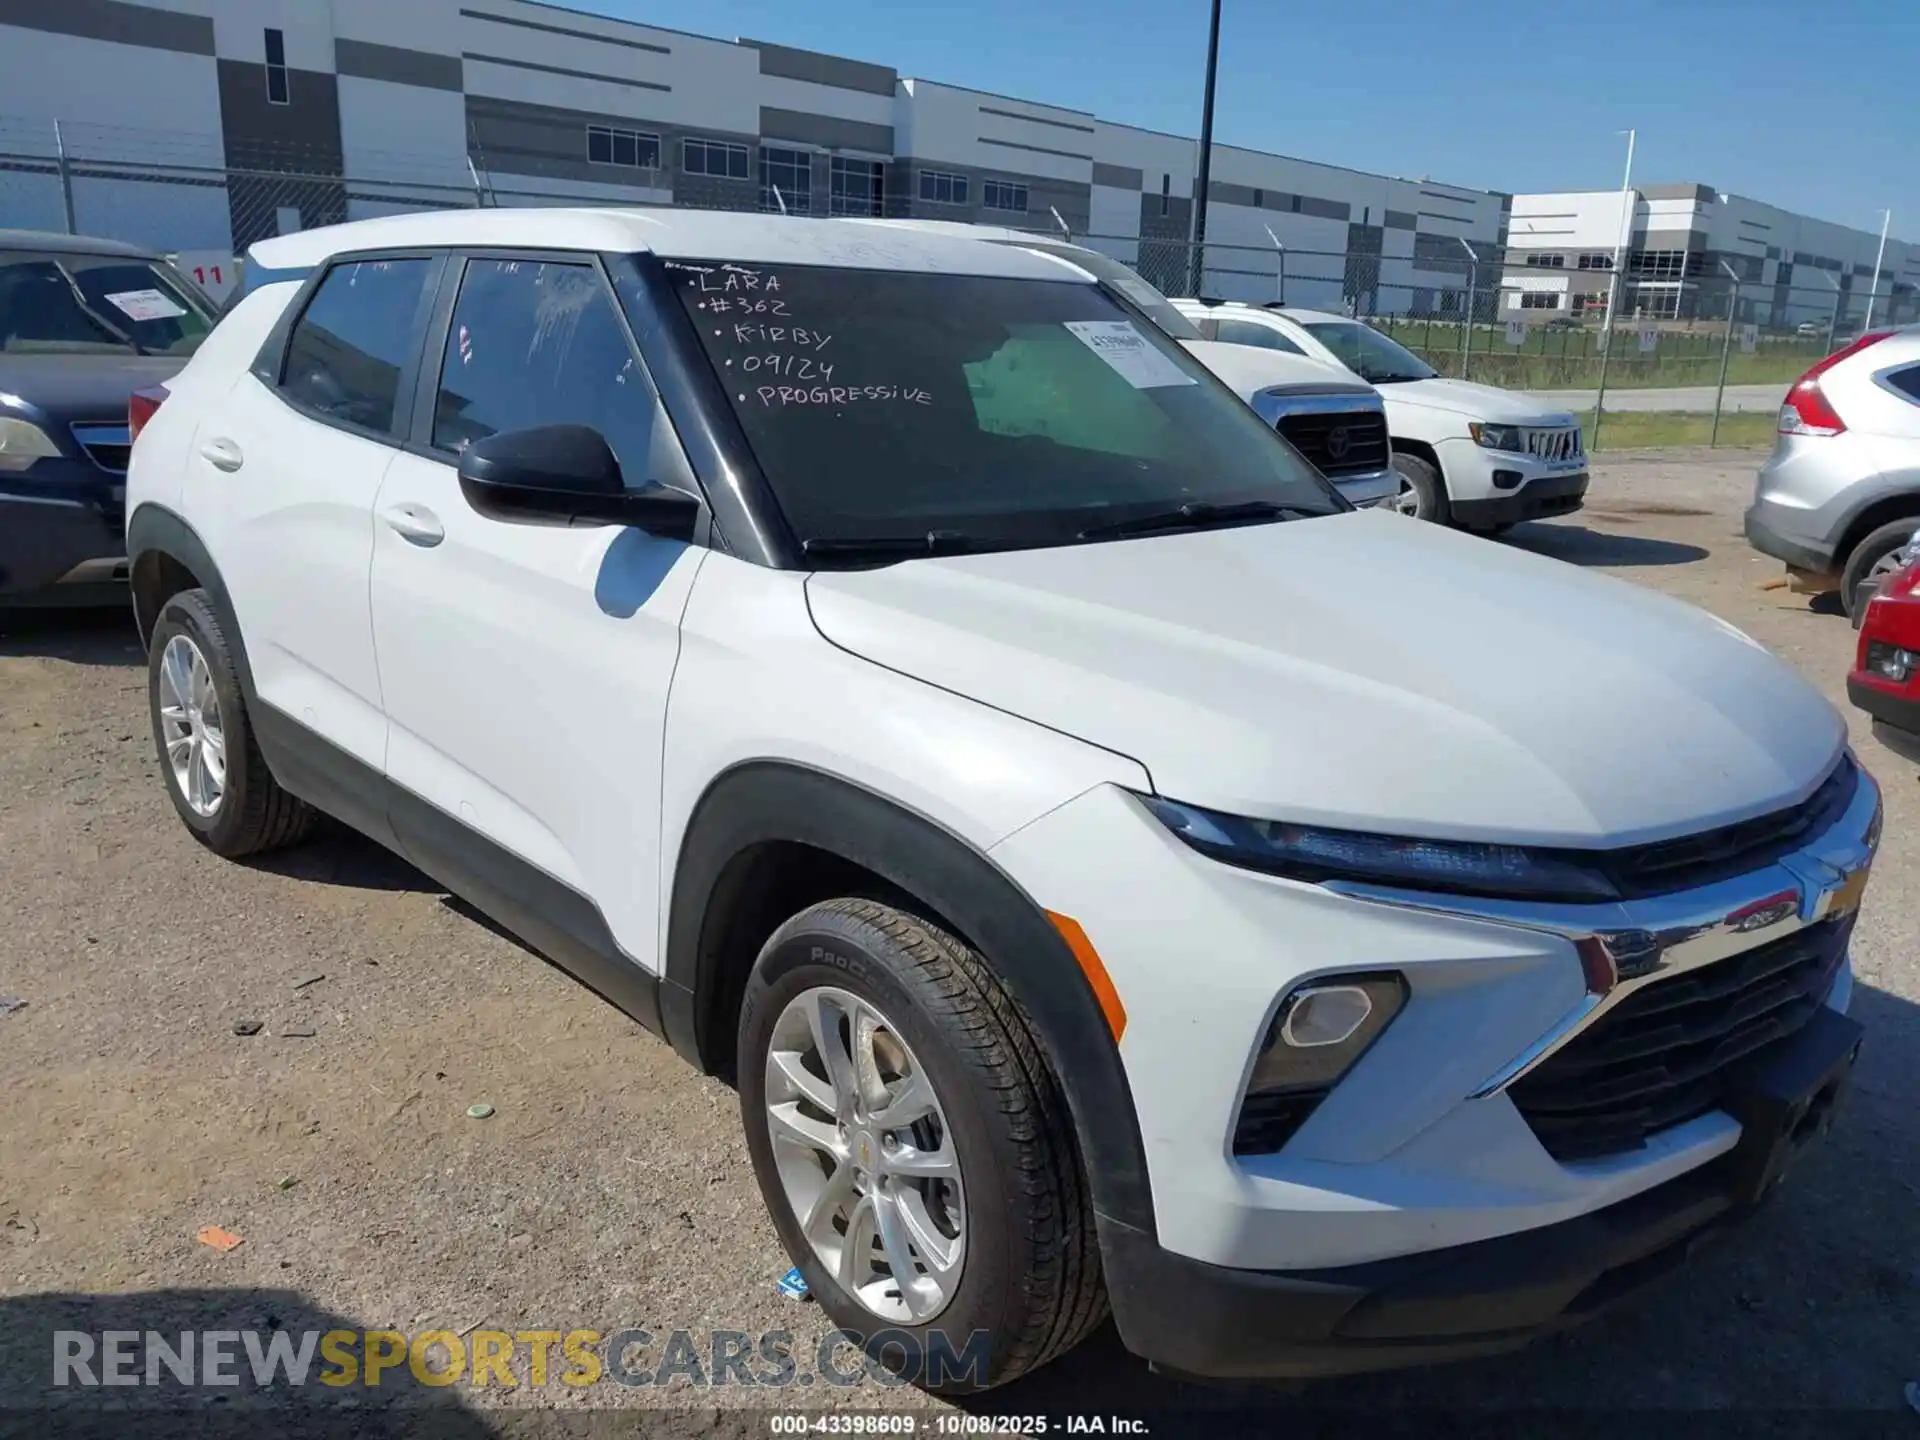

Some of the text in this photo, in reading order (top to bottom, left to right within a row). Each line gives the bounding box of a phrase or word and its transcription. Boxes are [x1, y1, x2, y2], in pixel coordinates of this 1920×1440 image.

[193, 266, 221, 285] 11
[701, 273, 780, 292] LARA
[743, 355, 834, 382] 09/24
